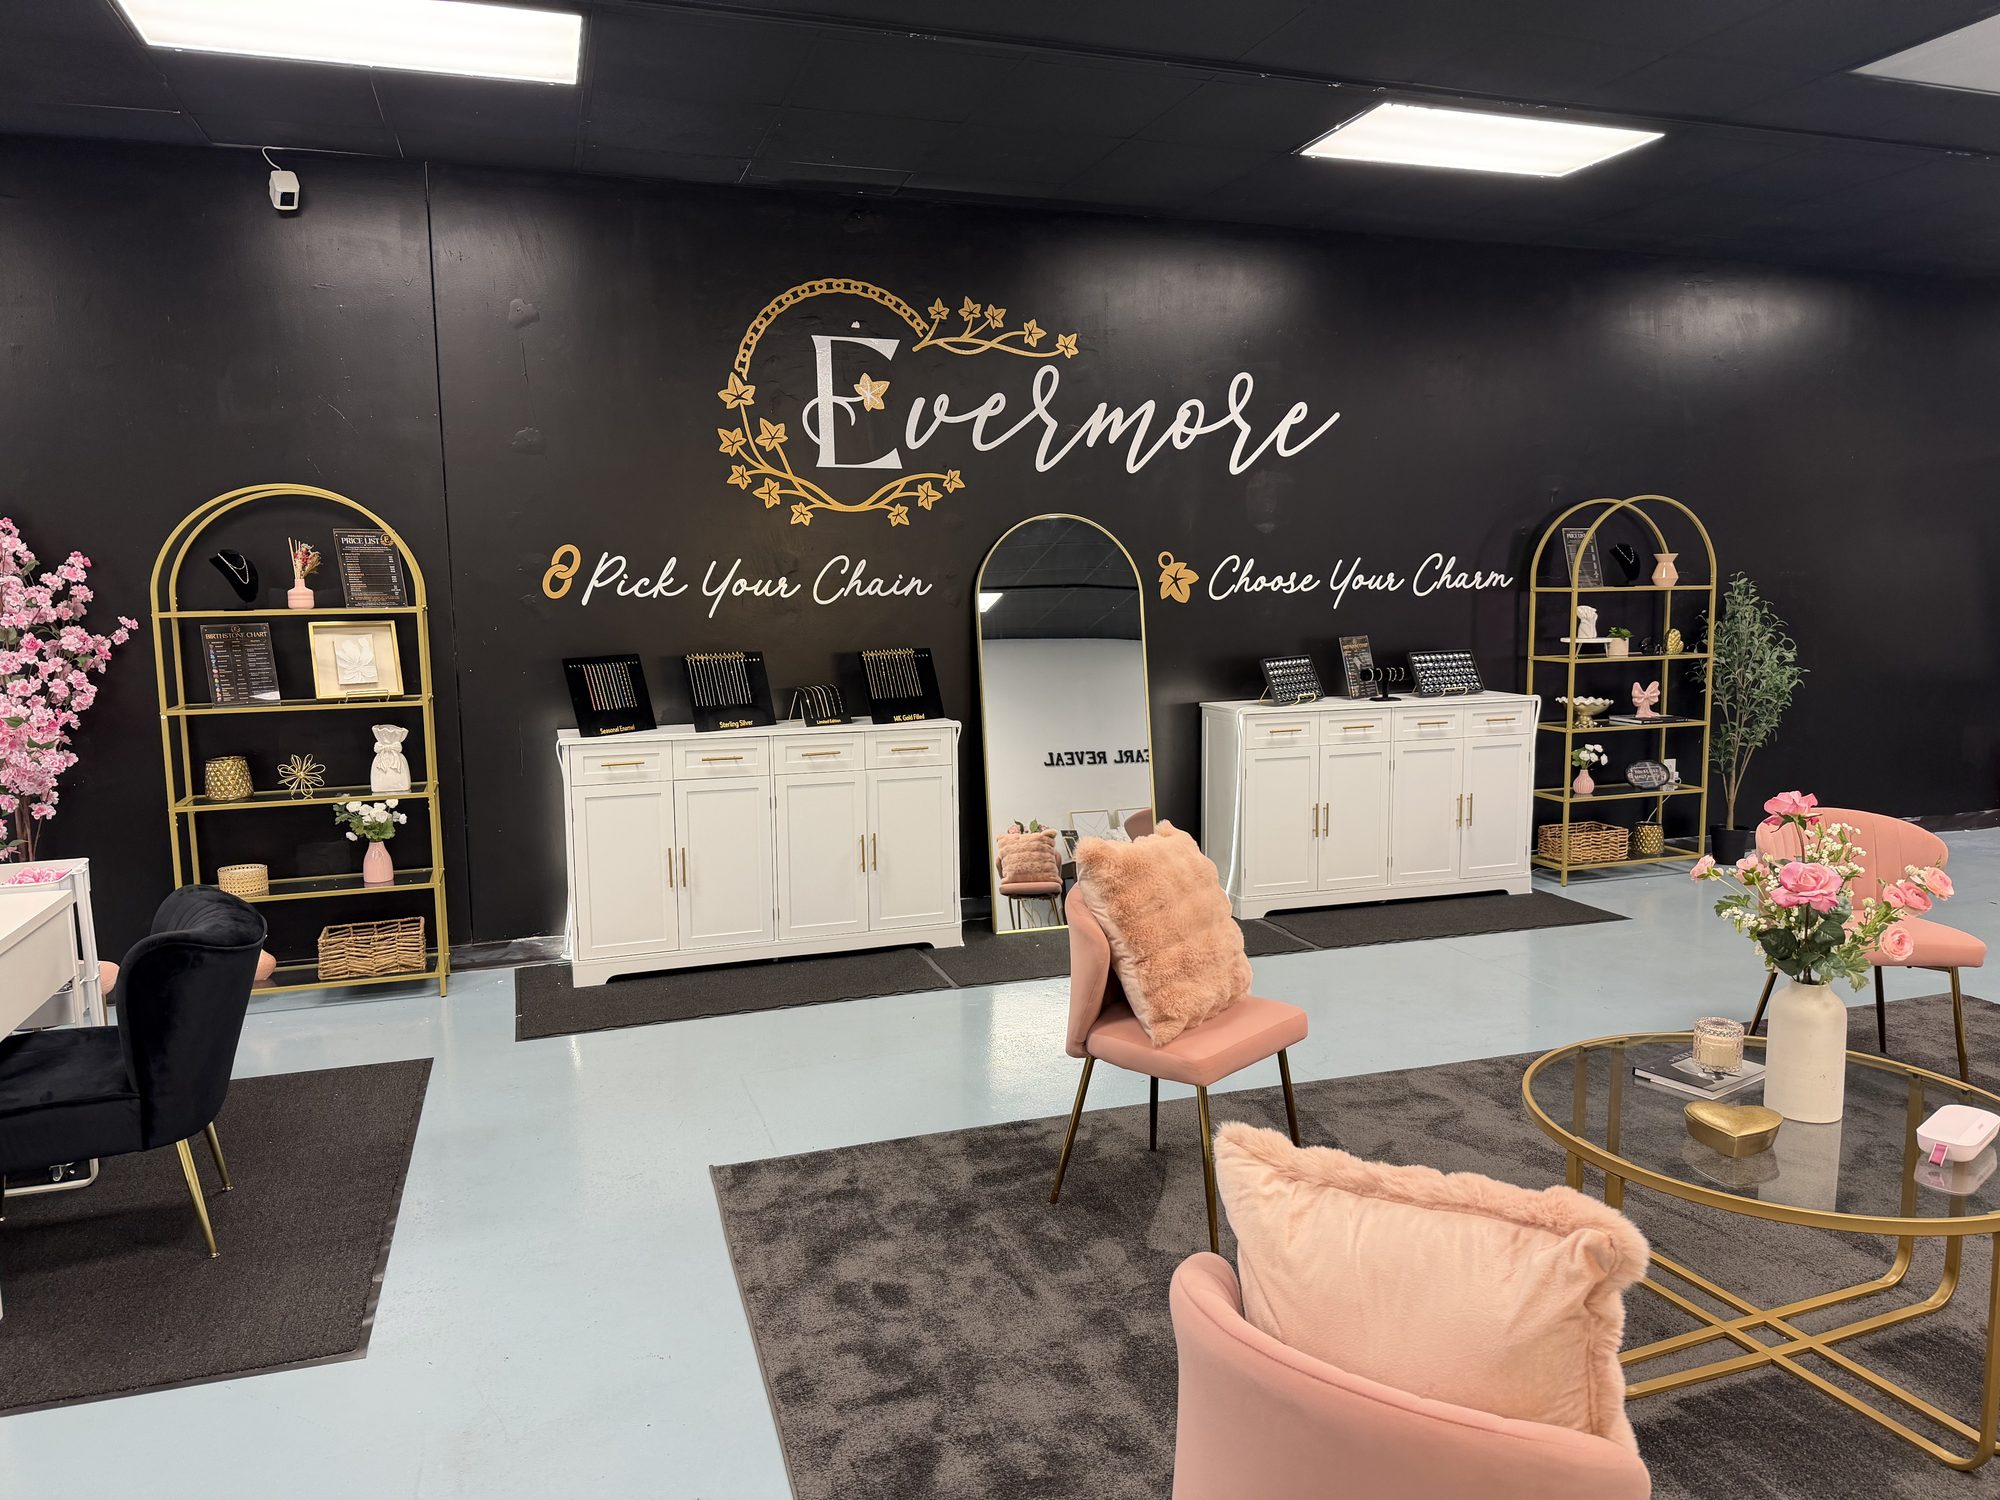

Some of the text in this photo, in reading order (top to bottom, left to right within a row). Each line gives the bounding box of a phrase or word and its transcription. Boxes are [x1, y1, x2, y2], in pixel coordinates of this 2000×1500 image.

[801, 333, 1341, 476] Evermore
[341, 537, 380, 545] PRICE LIST
[581, 551, 933, 619] Pick Your Chain
[1208, 554, 1321, 601] Choose
[1329, 556, 1405, 610] Your
[1412, 552, 1514, 597] Charm
[719, 719, 753, 729] Sterling Silver
